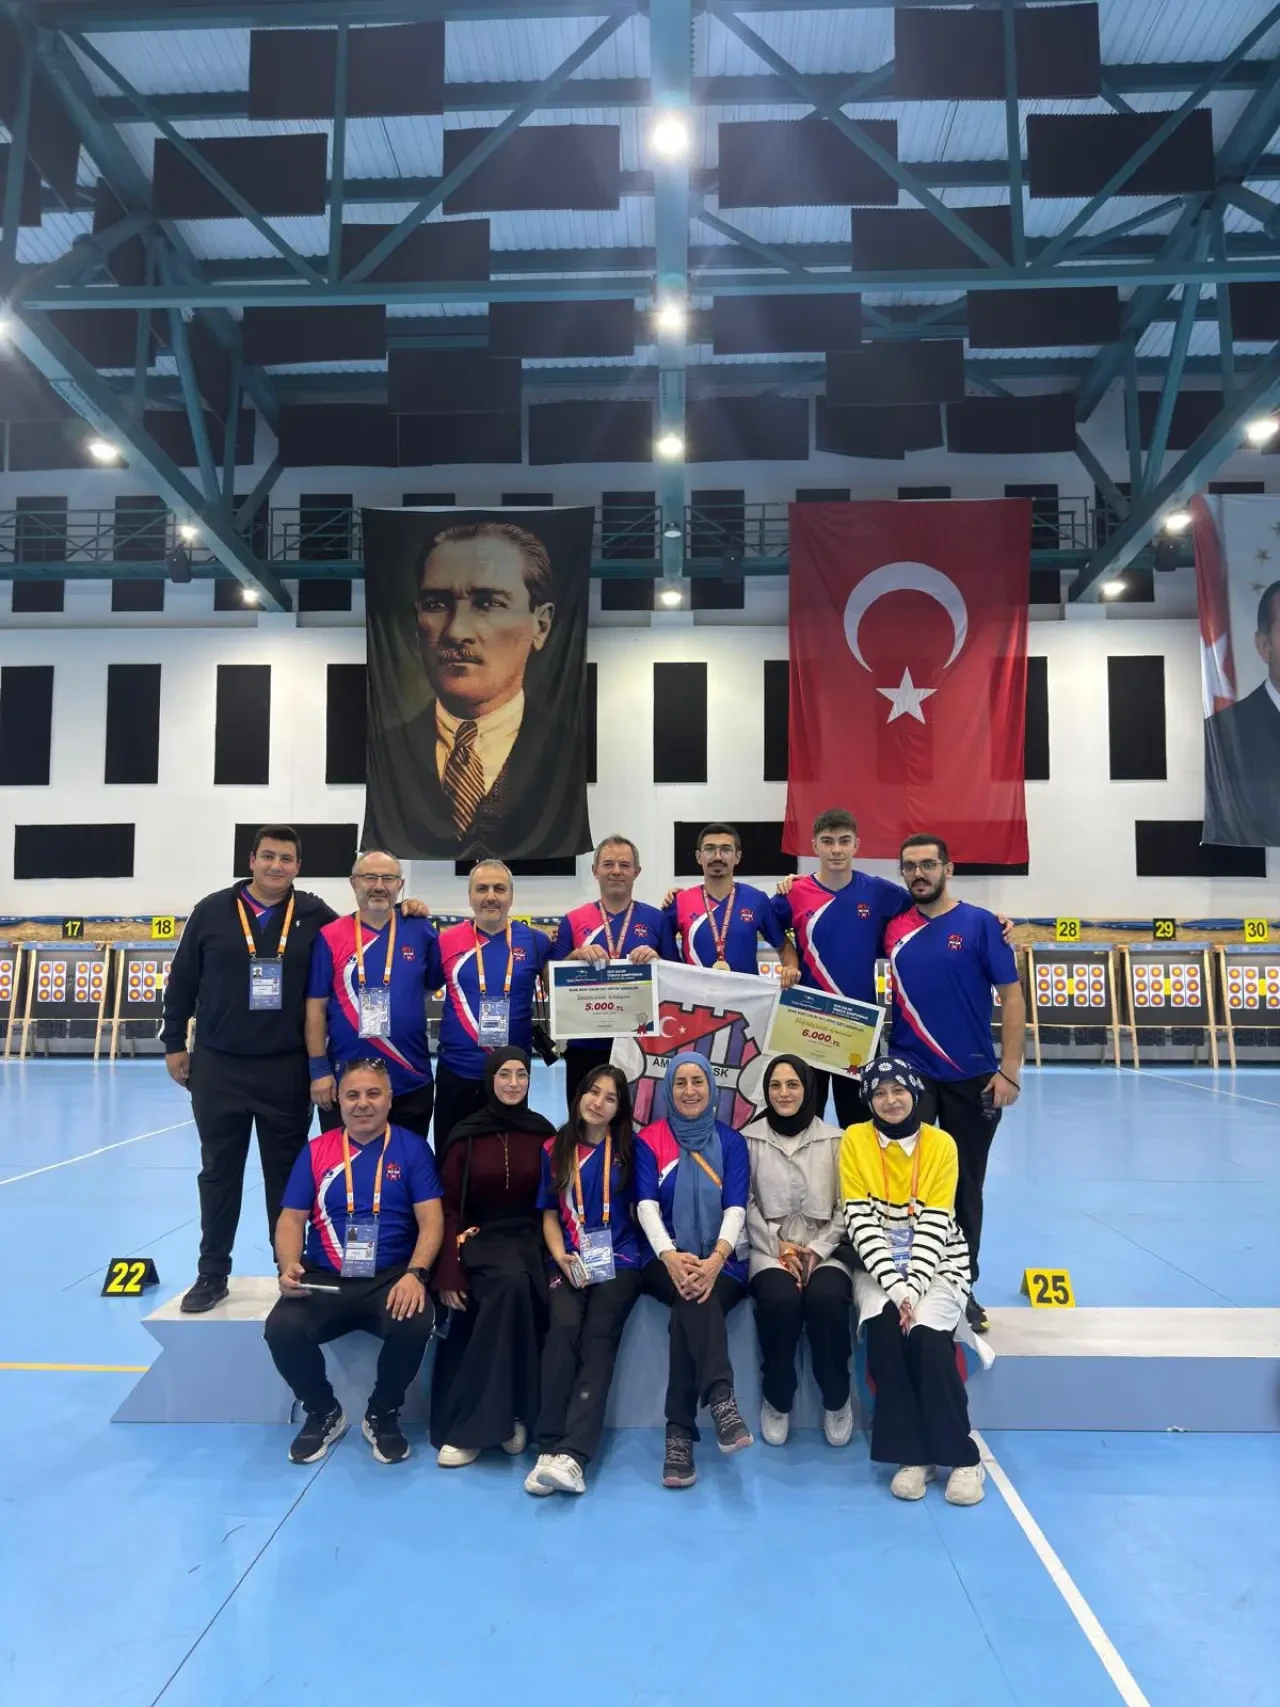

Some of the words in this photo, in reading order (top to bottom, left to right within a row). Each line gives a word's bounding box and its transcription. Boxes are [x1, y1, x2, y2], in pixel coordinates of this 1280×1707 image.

[65, 920, 81, 937] 17
[154, 919, 172, 935] 18
[1059, 921, 1077, 937] 28
[1155, 921, 1174, 938] 29
[1247, 922, 1265, 938] 30
[106, 1261, 146, 1293] 22
[1032, 1274, 1069, 1305] 25
